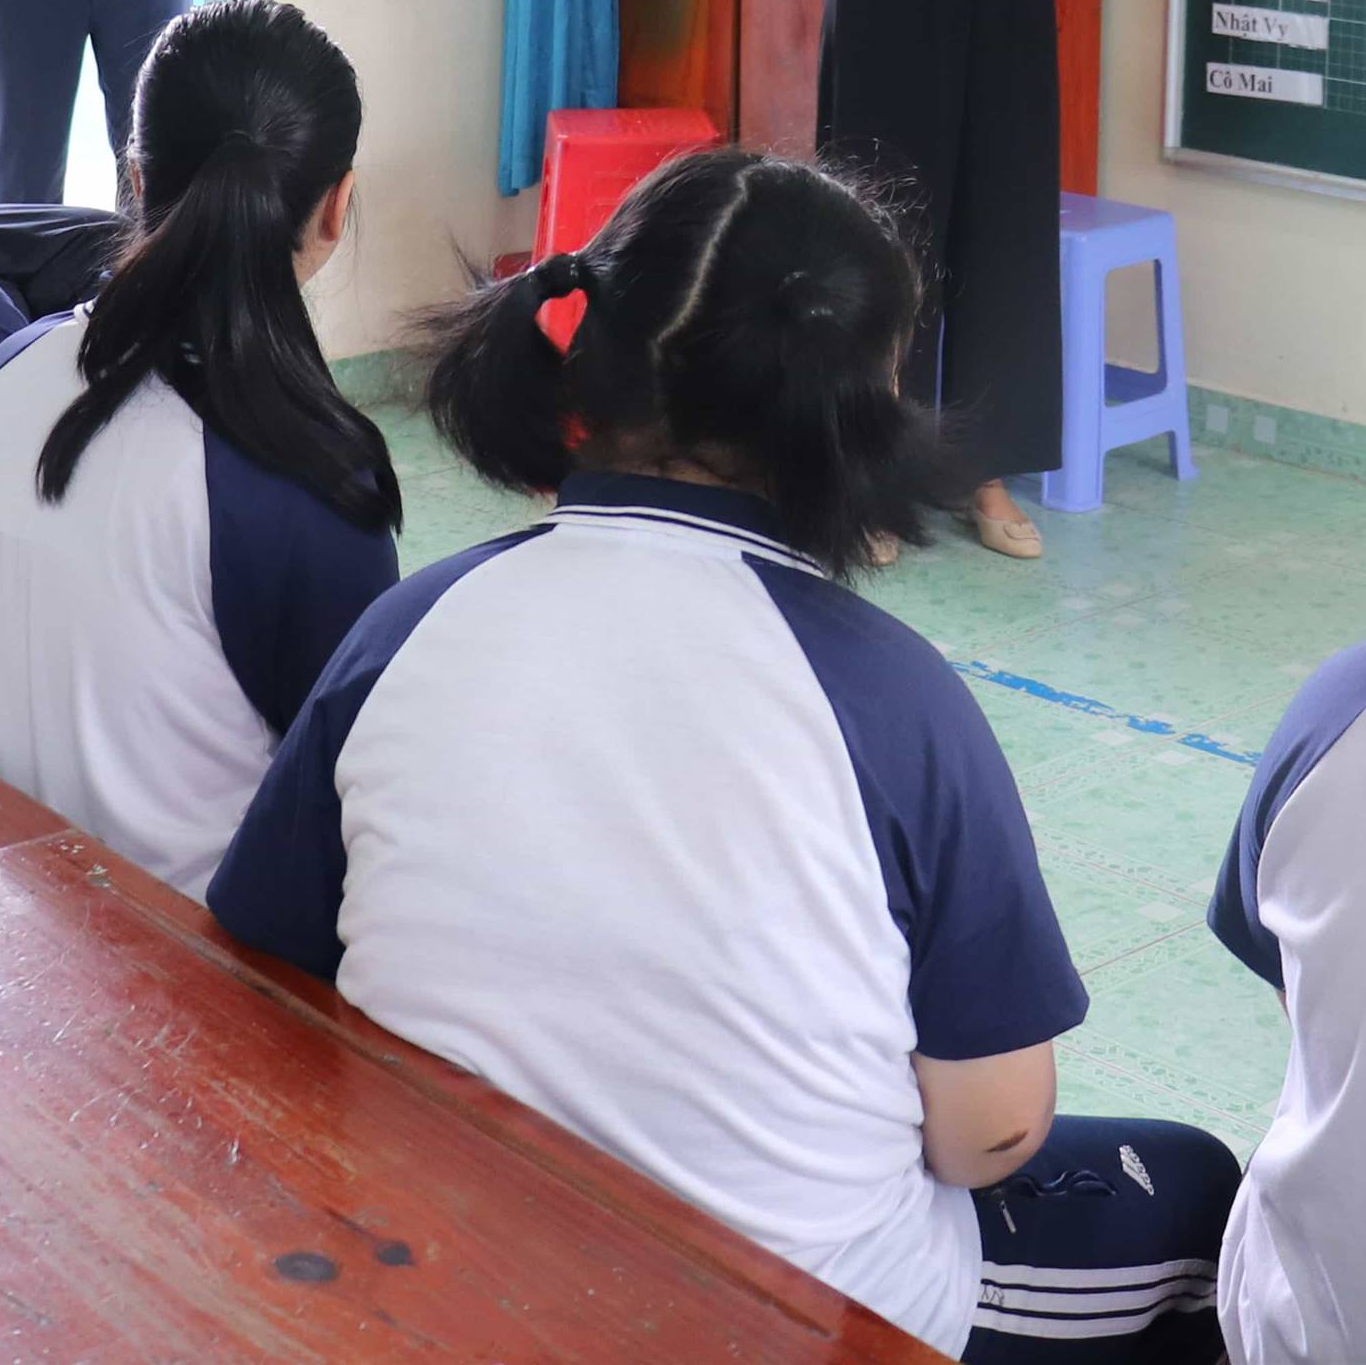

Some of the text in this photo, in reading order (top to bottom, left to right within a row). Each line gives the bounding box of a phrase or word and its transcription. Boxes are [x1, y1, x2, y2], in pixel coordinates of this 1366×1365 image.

[1216, 11, 1290, 41] Nhật Vy
[1209, 69, 1272, 93] Cô Mai
